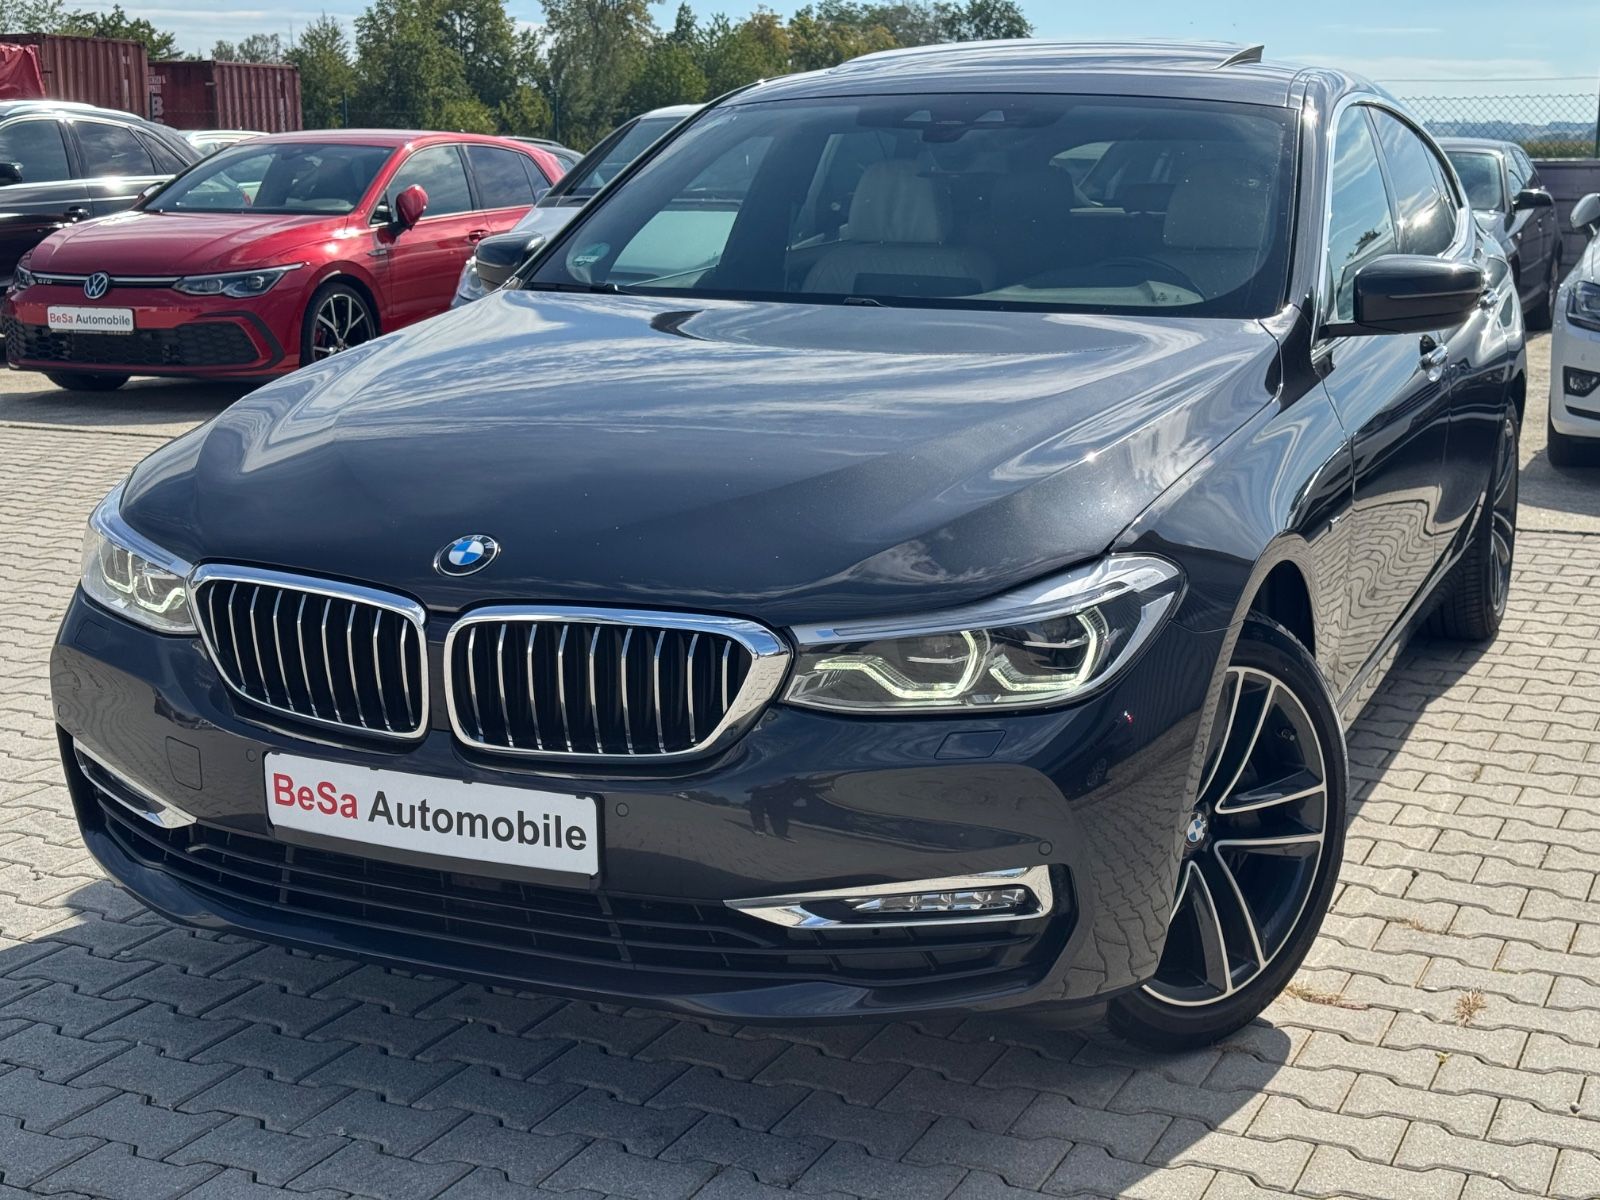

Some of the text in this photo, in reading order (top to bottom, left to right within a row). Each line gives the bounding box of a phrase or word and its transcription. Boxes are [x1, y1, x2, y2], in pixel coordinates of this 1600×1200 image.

[49, 312, 131, 326] BeSa Automobile
[273, 773, 587, 851] BeSa Automobile
